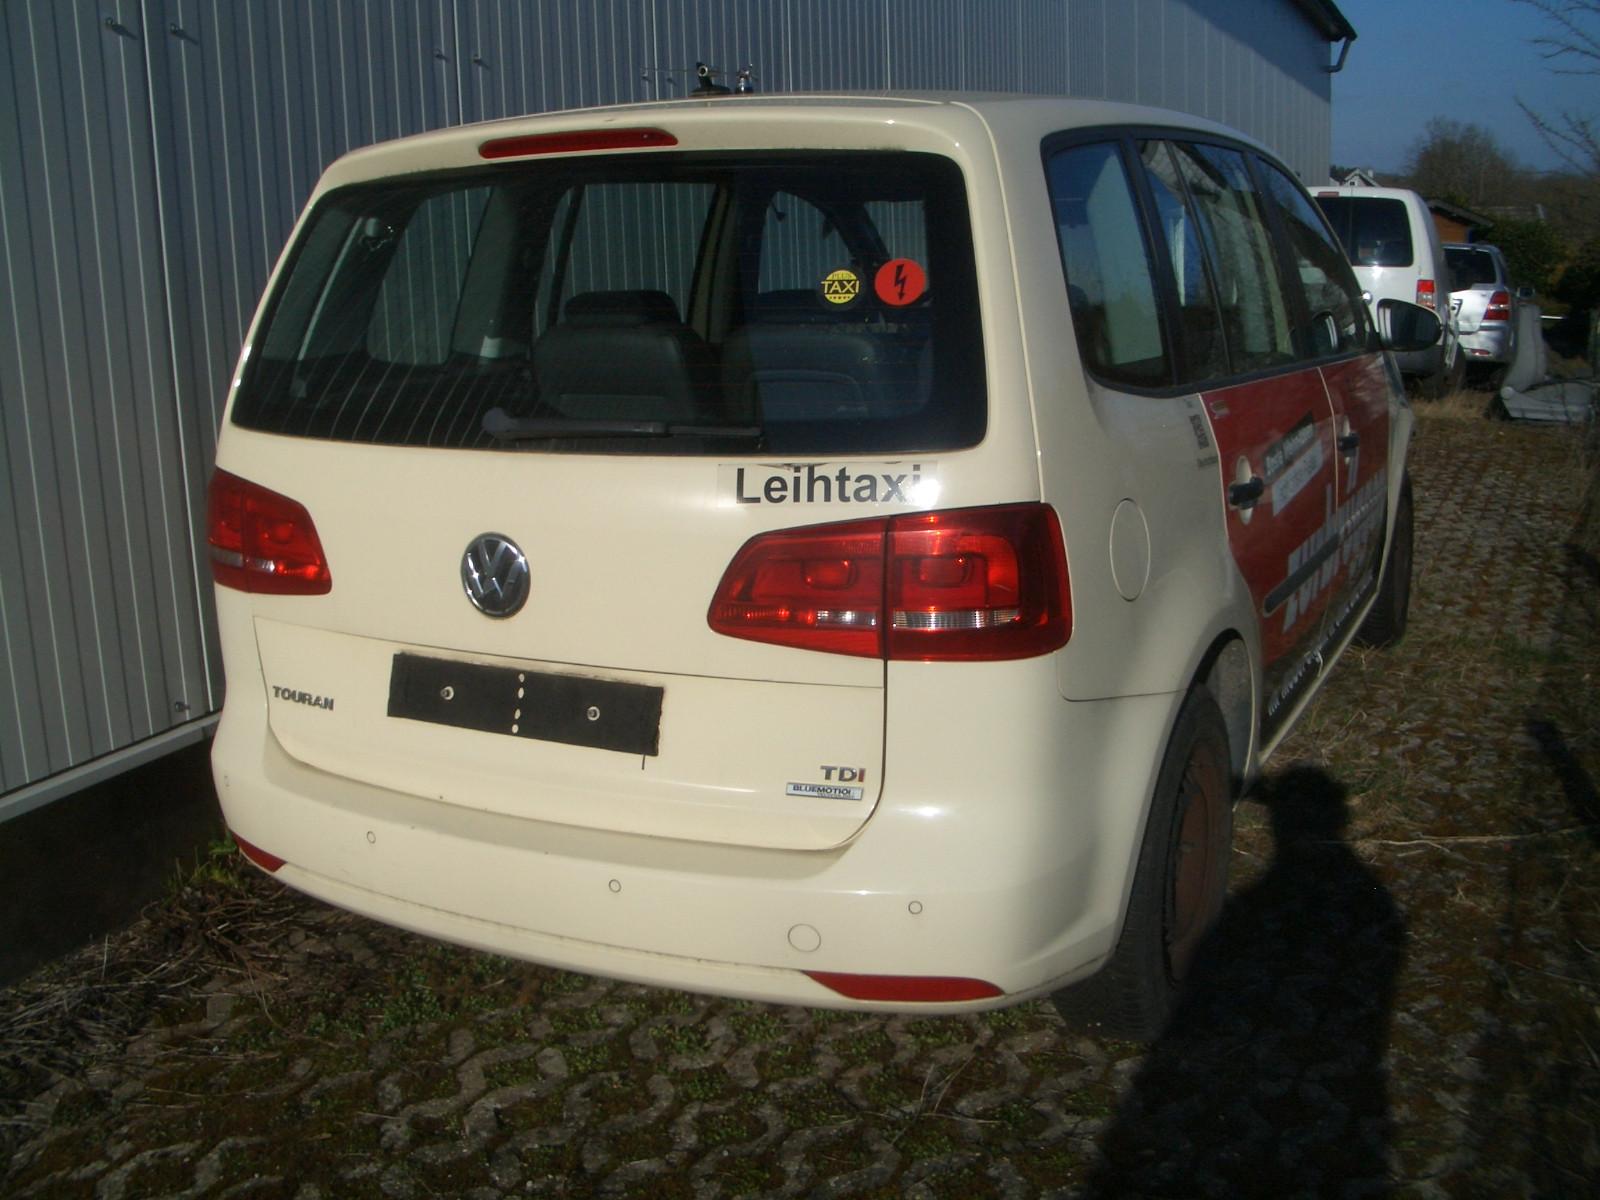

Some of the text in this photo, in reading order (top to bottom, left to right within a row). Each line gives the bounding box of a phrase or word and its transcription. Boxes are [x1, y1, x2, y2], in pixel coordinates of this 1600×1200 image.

[821, 280, 860, 294] TAXI
[736, 463, 922, 504] Leihtaxi
[272, 685, 335, 711] TOURAN
[820, 765, 865, 782] TDI
